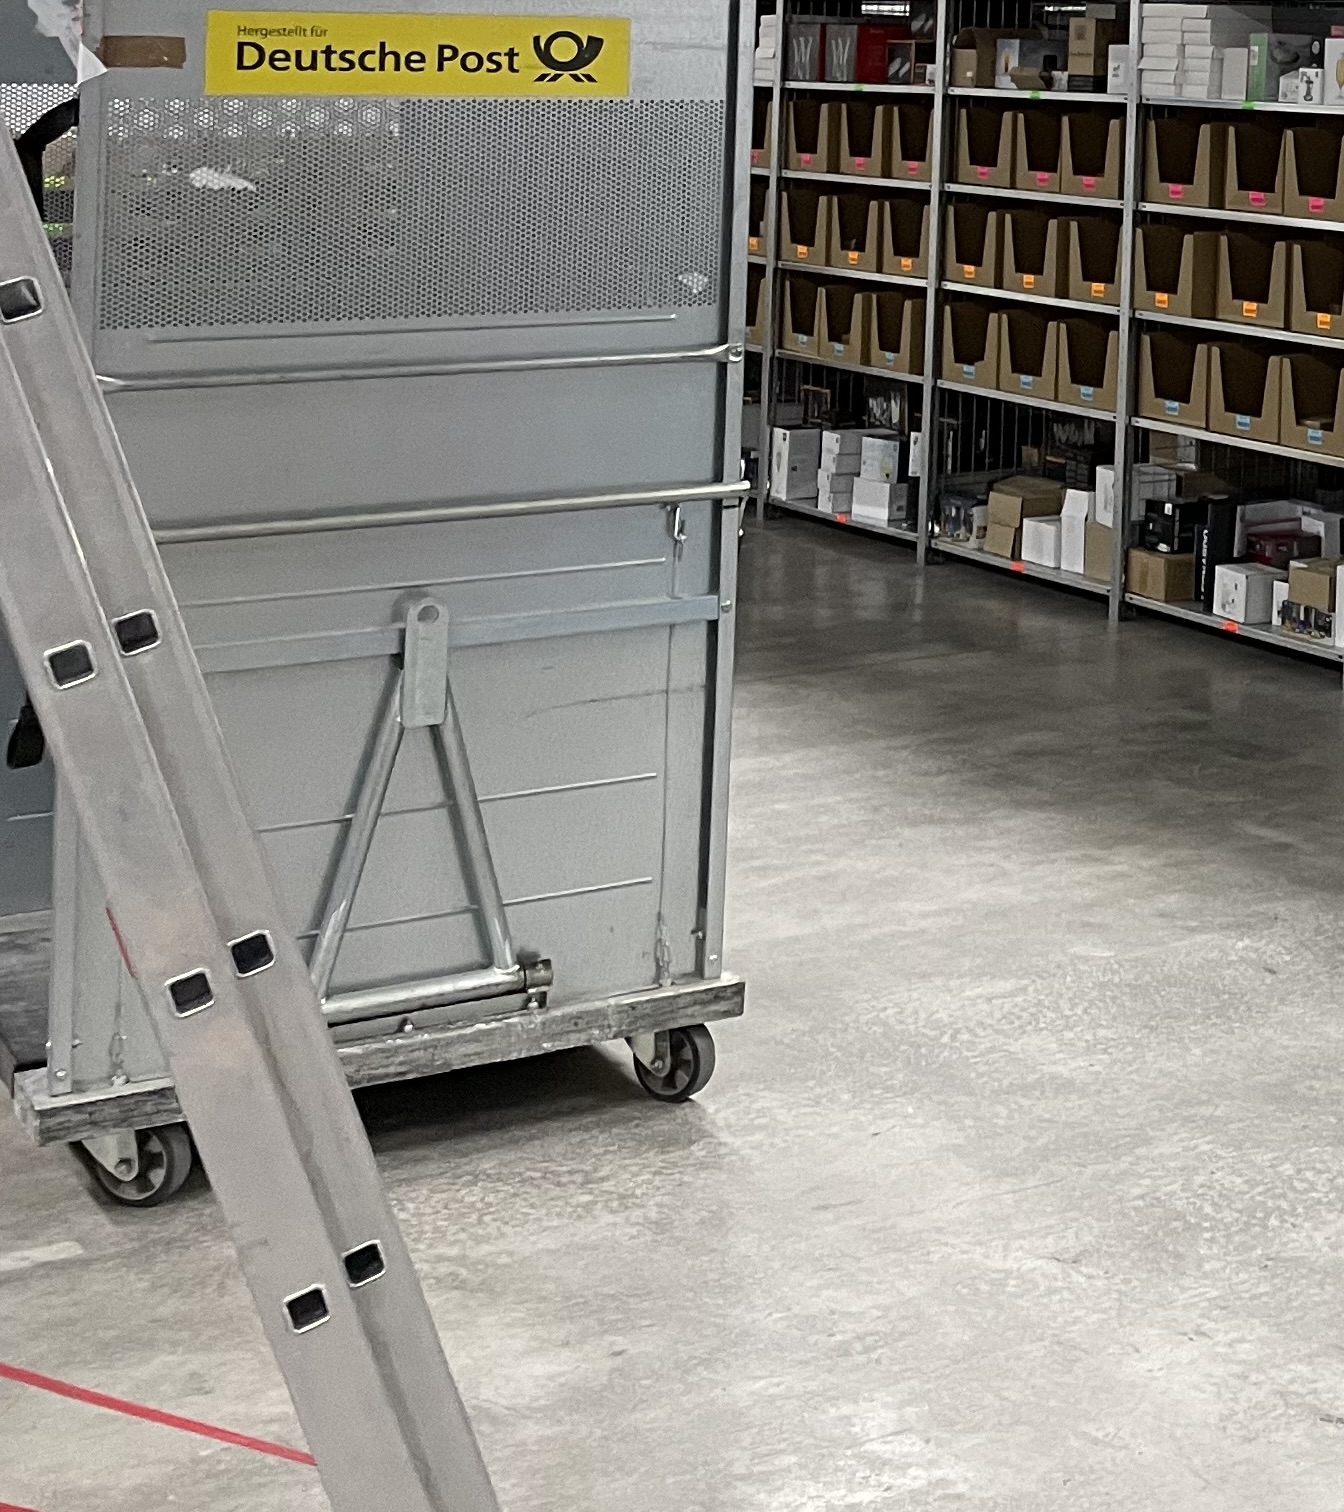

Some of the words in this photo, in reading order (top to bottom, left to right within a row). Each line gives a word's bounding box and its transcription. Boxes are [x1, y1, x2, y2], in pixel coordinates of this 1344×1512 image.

[236, 25, 308, 39] Hergestellt
[310, 25, 328, 38] für
[236, 41, 427, 73] Deutsche
[437, 44, 520, 74] Post
